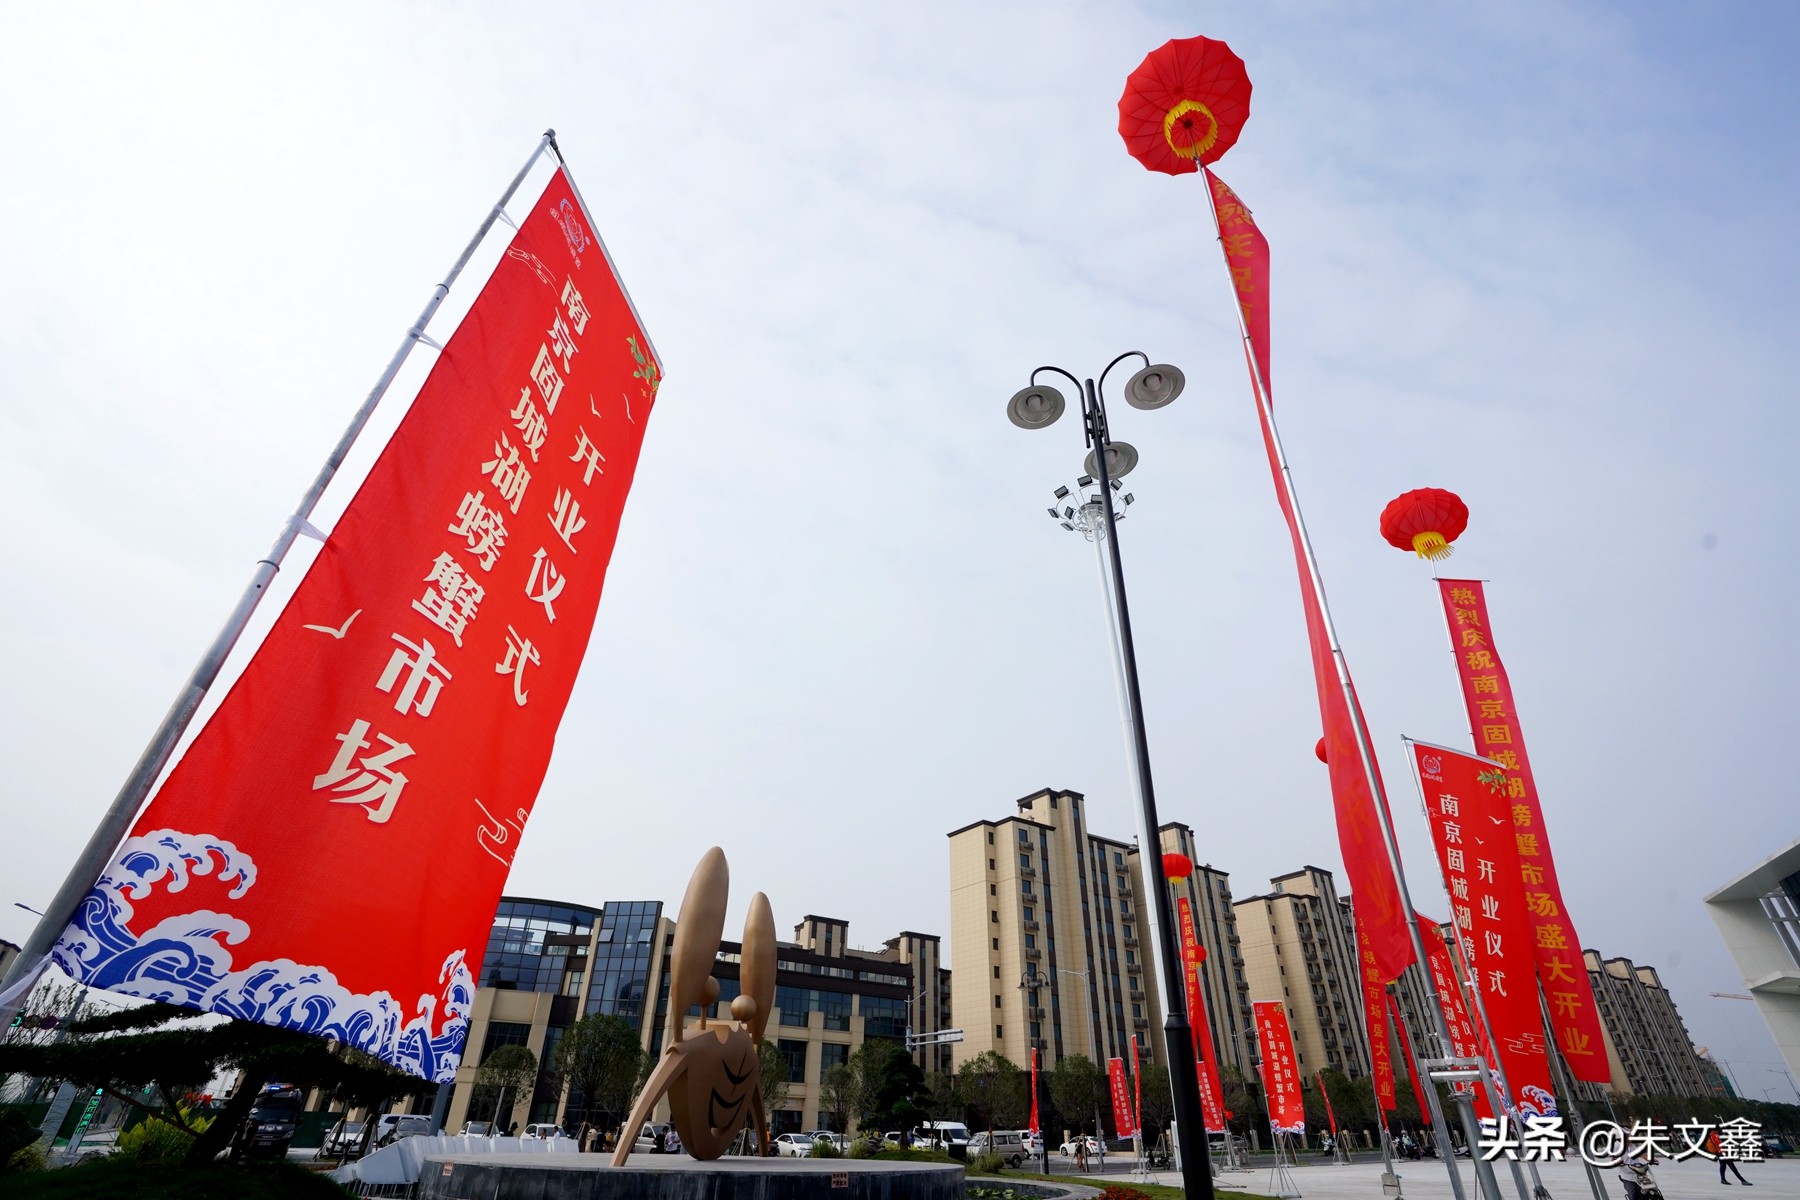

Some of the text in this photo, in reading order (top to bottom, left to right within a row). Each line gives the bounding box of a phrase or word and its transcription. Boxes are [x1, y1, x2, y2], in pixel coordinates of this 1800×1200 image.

[312, 273, 592, 825] 南京固城湖螃蟹市场
[494, 424, 606, 707] 开业仪式
[1476, 858, 1508, 998] 开业仪式
